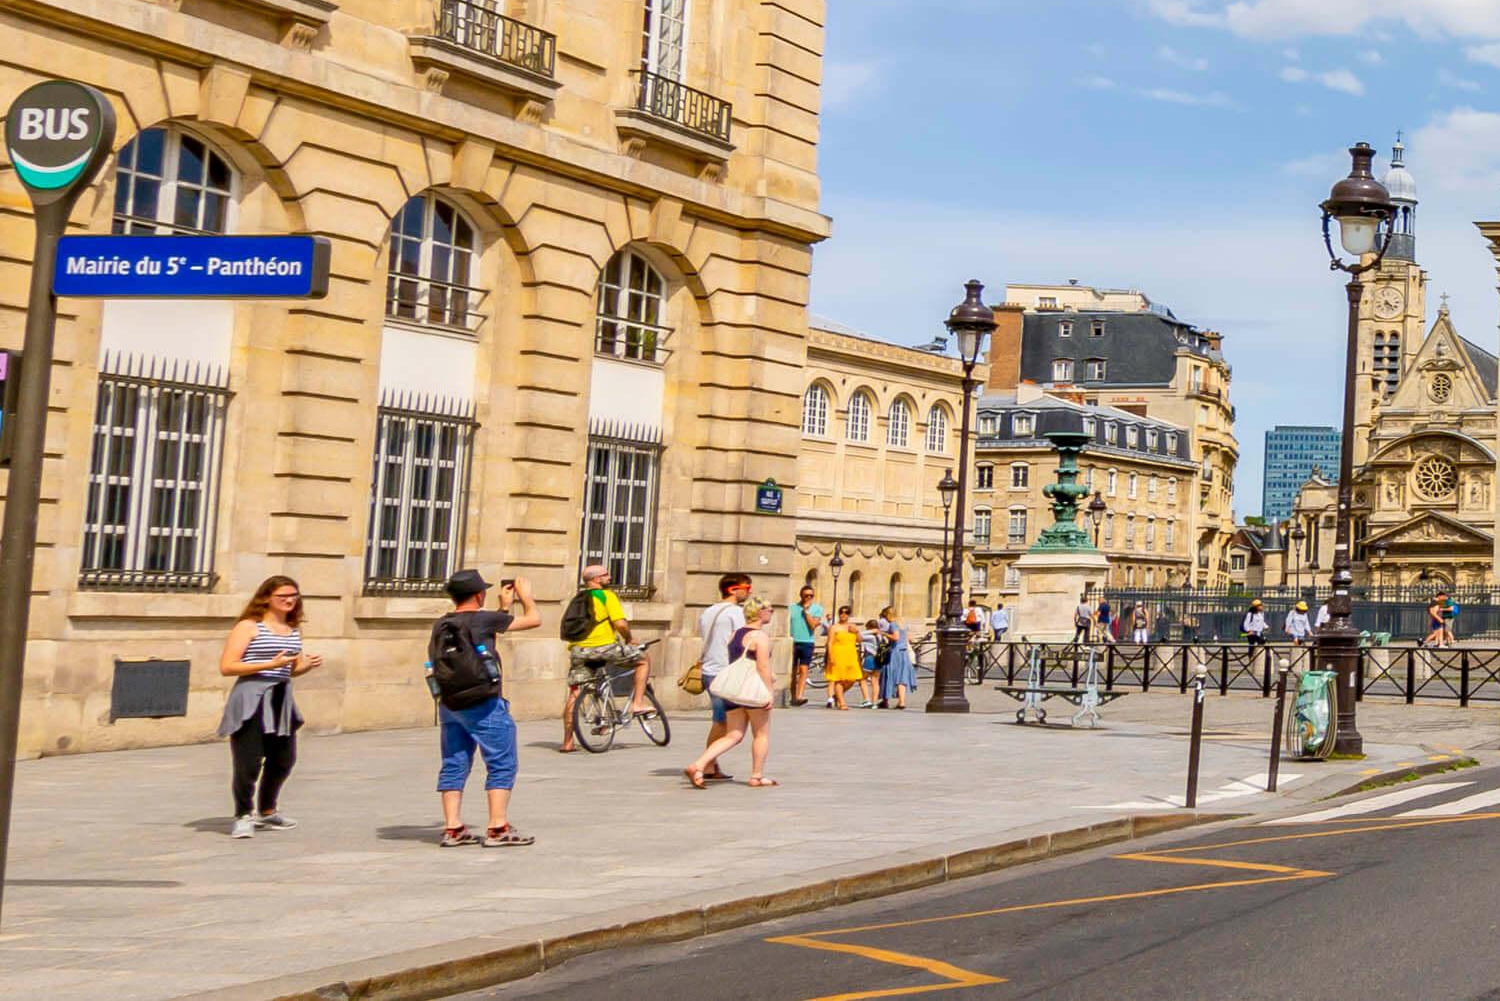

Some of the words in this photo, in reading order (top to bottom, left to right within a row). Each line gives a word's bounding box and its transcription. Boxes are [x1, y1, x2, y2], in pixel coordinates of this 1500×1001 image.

[19, 107, 90, 141] BUS
[66, 255, 131, 276] Mairie
[135, 255, 162, 275] du
[207, 256, 303, 276] Panthéon
